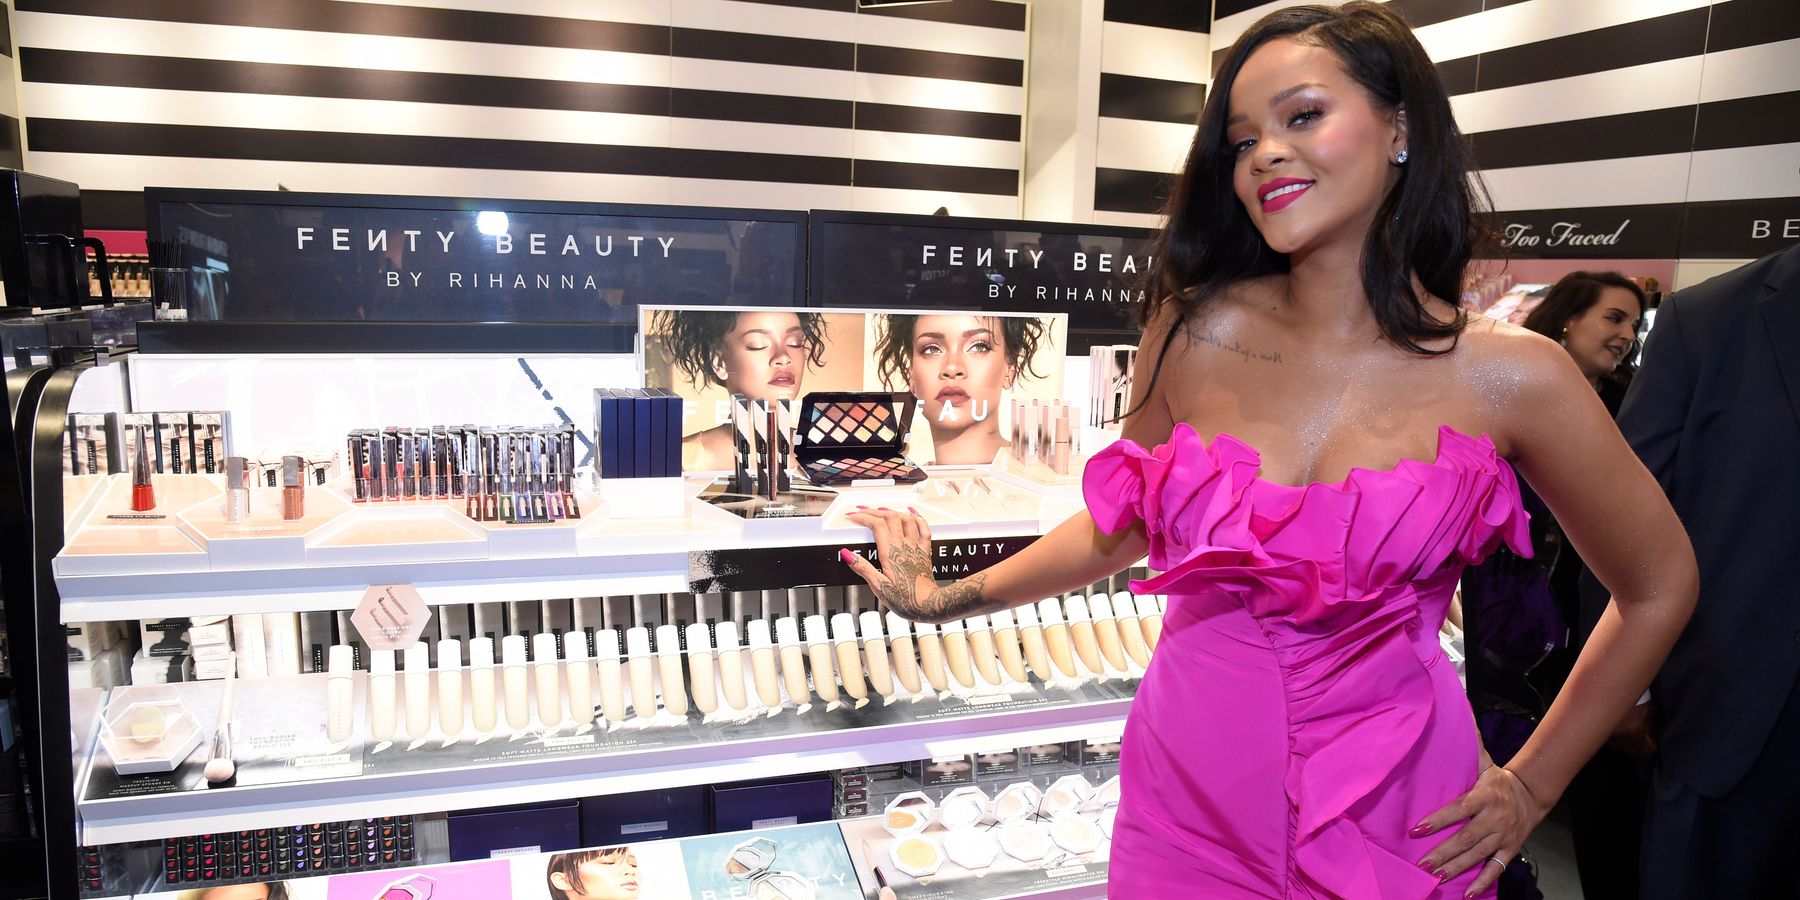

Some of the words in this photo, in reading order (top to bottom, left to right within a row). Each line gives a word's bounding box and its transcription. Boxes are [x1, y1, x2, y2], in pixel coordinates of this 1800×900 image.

[1501, 223, 1541, 248] Too
[1546, 219, 1631, 248] Faced
[495, 232, 675, 258] BEAUTY
[1073, 252, 1153, 274] BEA
[386, 271, 423, 287] BY
[449, 272, 597, 290] RIHANNA
[988, 284, 1017, 299] BY
[1036, 286, 1146, 303] RIHANNA
[930, 543, 1005, 558] EAUTY
[932, 564, 970, 575] ANNA
